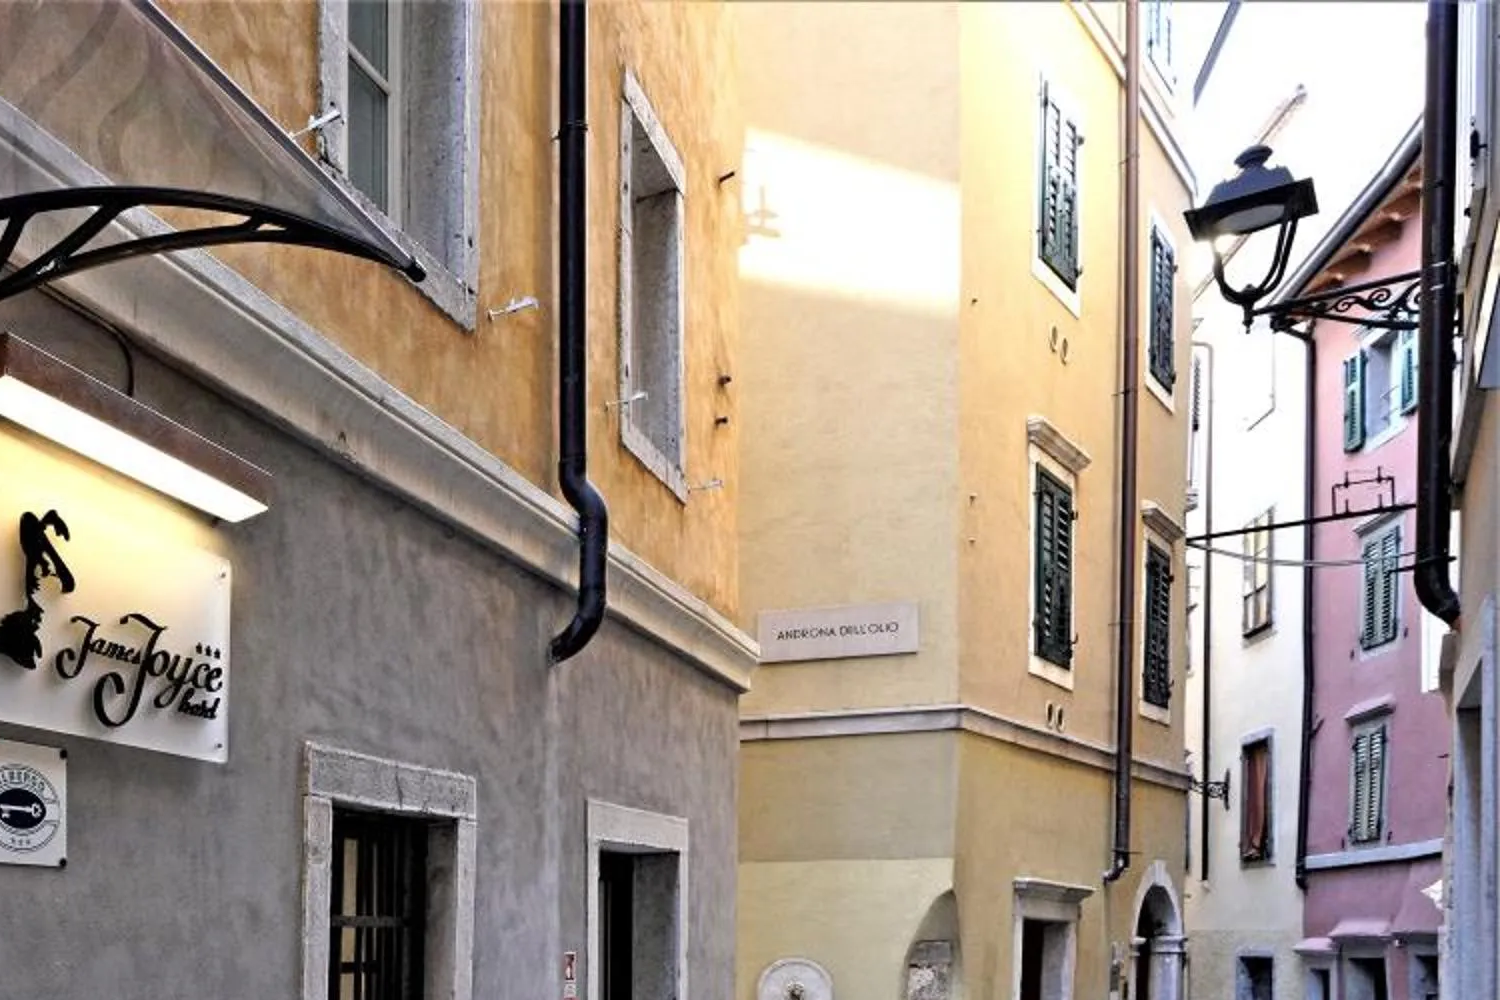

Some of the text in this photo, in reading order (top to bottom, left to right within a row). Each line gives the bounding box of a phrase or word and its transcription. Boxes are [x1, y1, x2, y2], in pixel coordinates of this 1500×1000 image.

[776, 621, 899, 641] ANDRONA DELL'OLIO
[56, 613, 223, 727] James Joyce
